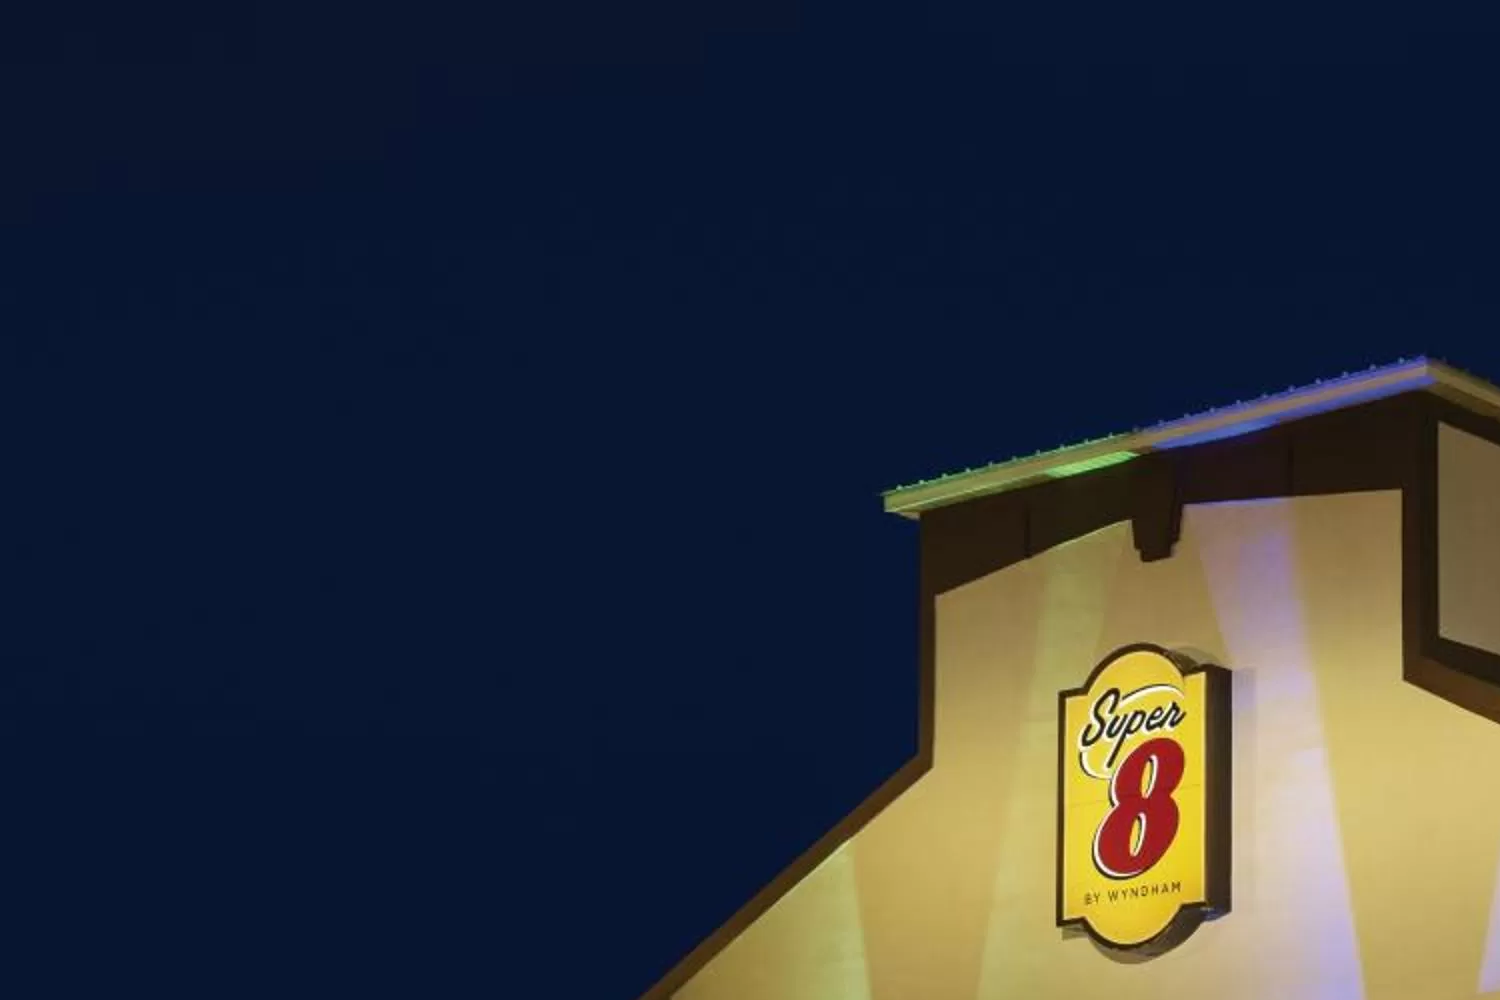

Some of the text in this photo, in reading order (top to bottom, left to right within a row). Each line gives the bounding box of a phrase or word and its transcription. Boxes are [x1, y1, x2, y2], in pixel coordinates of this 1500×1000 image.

[1080, 686, 1186, 769] Super
[1092, 737, 1186, 880] 8
[1084, 880, 1182, 905] BY WYNDHAM
